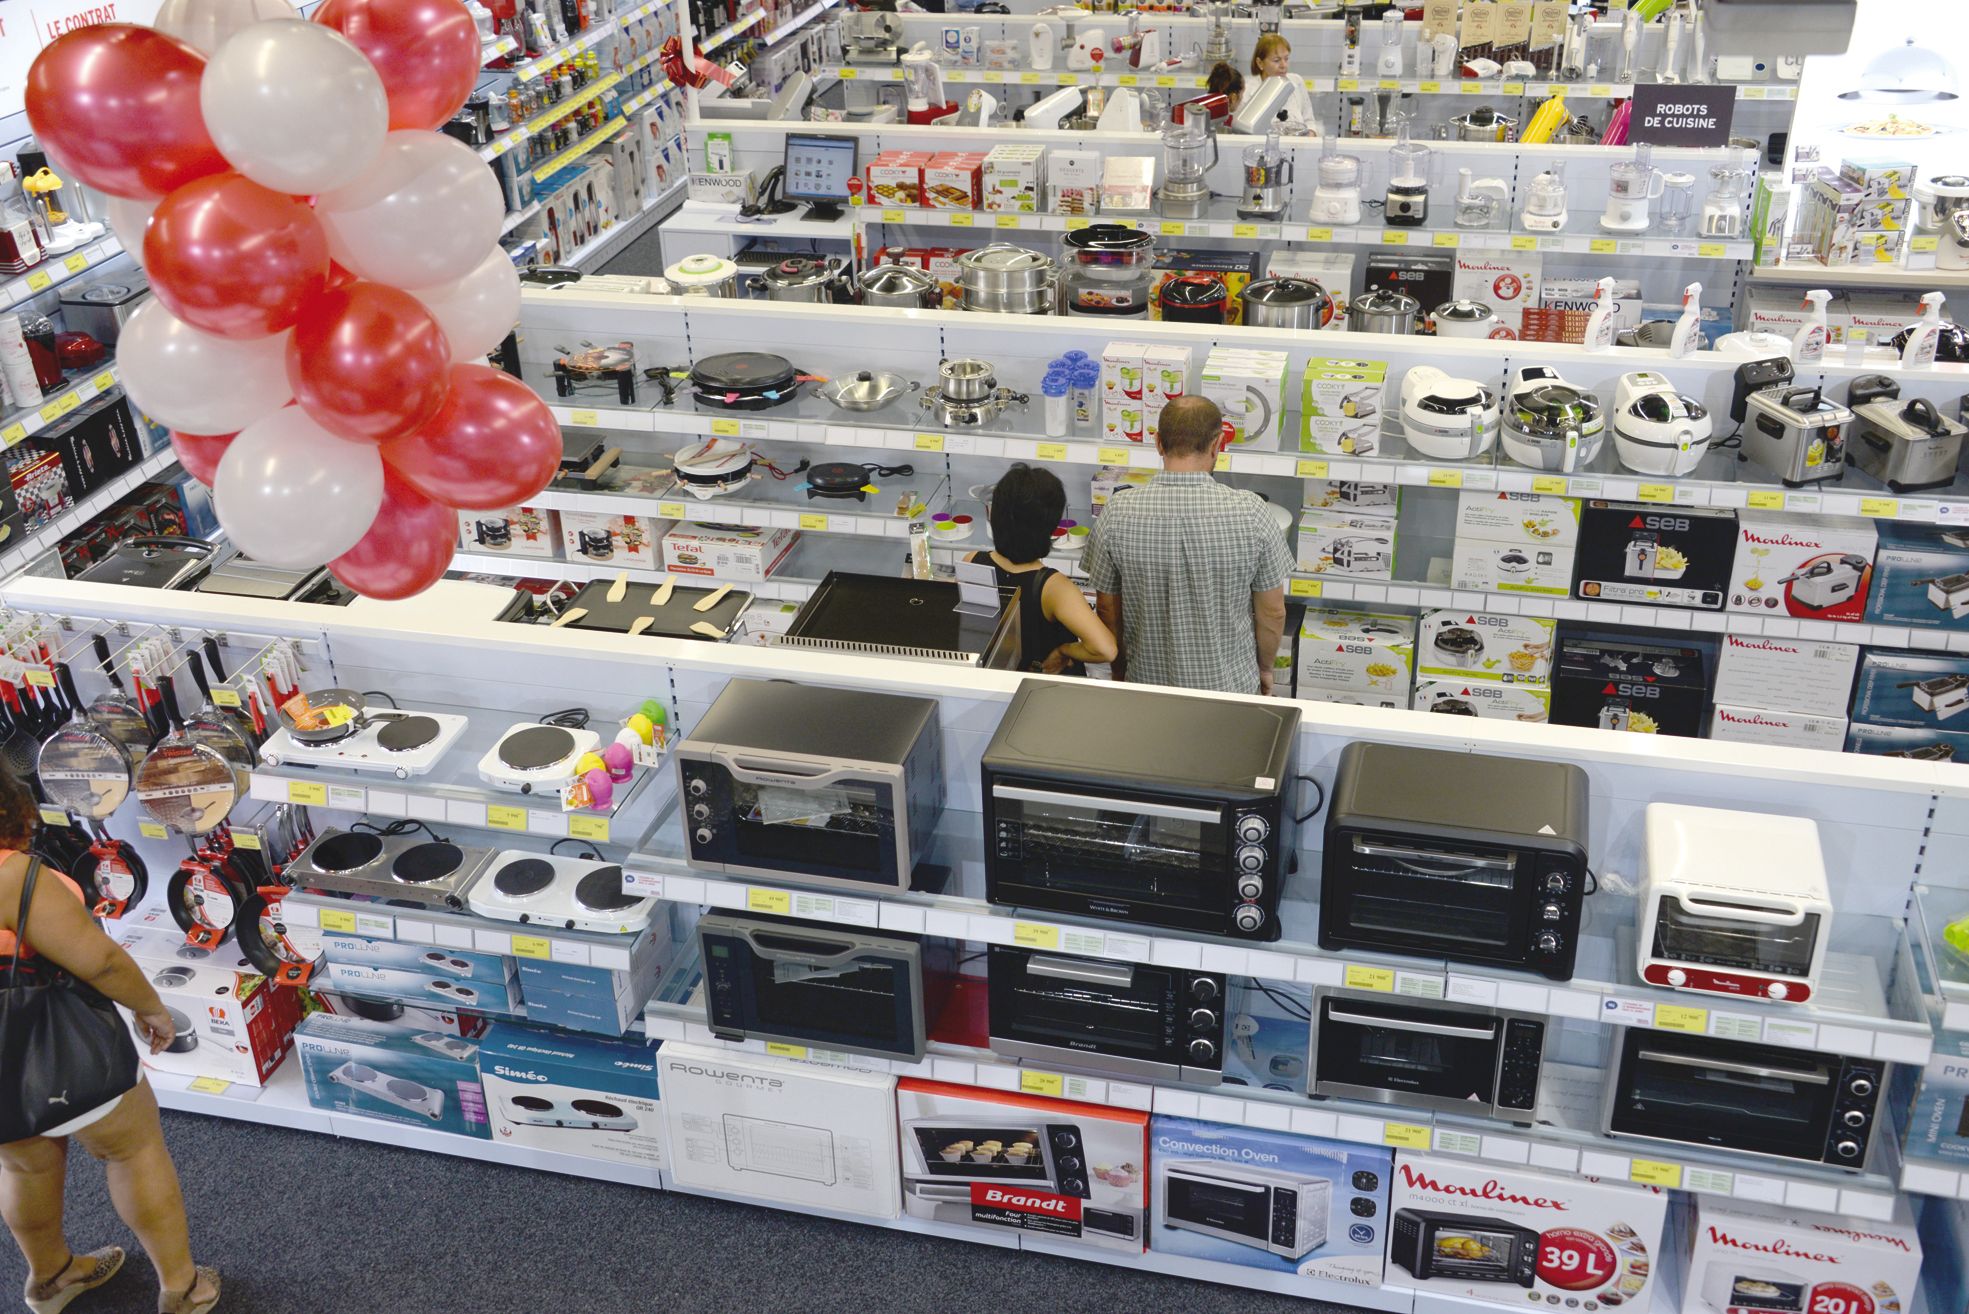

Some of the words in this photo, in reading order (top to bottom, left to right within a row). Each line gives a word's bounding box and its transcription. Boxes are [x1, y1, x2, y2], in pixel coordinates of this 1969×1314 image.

[47, 22, 61, 39] LE
[65, 4, 117, 33] CONTRAT
[1656, 104, 1708, 115] ROBOTS
[1644, 117, 1661, 127] DE
[1665, 117, 1717, 129] CUISINE
[670, 543, 704, 553] Tefal
[1742, 529, 1822, 549] Moulinex
[1727, 634, 1799, 654] Moulinex
[1718, 710, 1789, 728] Moulinex
[494, 1065, 548, 1082] Siméo
[715, 1079, 784, 1093] GOURMET
[1931, 1098, 1946, 1122] OVEN
[1927, 1123, 1940, 1143] MINI
[1159, 1137, 1238, 1157] Convection
[1241, 1149, 1279, 1163] Oven
[1399, 1164, 1569, 1211] Moulinex
[985, 1189, 1067, 1212] Brandt
[975, 1212, 1021, 1223] multifonction
[1546, 1230, 1571, 1239] horno
[1573, 1230, 1595, 1242] extra
[1708, 1225, 1842, 1264] Moulinex
[1542, 1246, 1580, 1271] 39
[1587, 1251, 1605, 1275] L
[1318, 1270, 1371, 1286] Electrolux
[1814, 1295, 1846, 1314] 20
